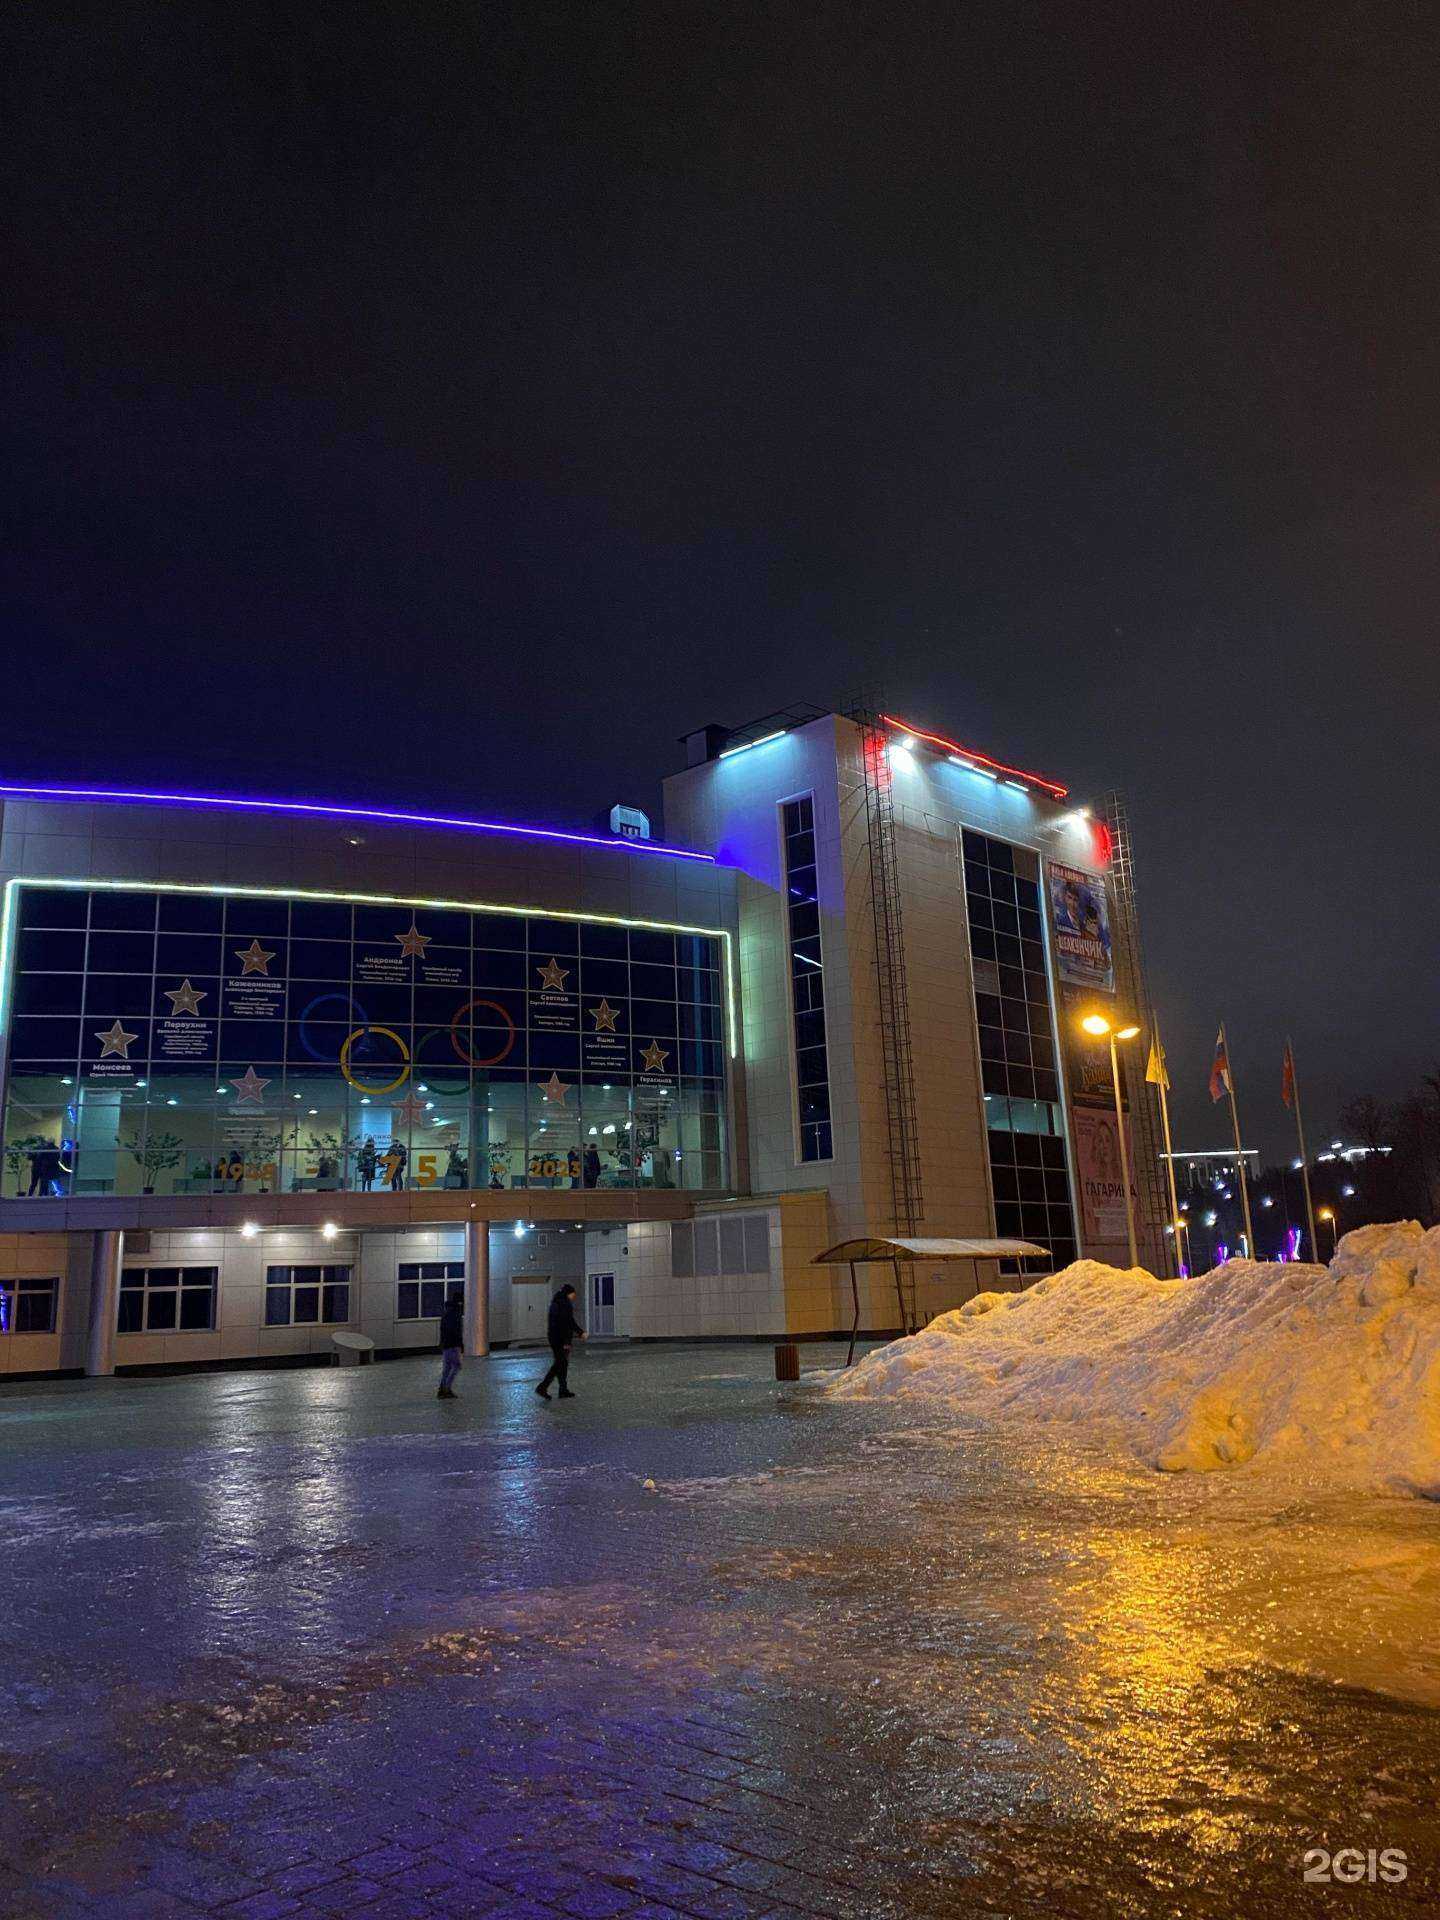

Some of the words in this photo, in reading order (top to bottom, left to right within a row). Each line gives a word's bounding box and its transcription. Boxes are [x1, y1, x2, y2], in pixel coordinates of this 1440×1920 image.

[163, 1020, 207, 1030] Первухин
[92, 1063, 132, 1072] Моисеев
[529, 1160, 581, 1178] 2023
